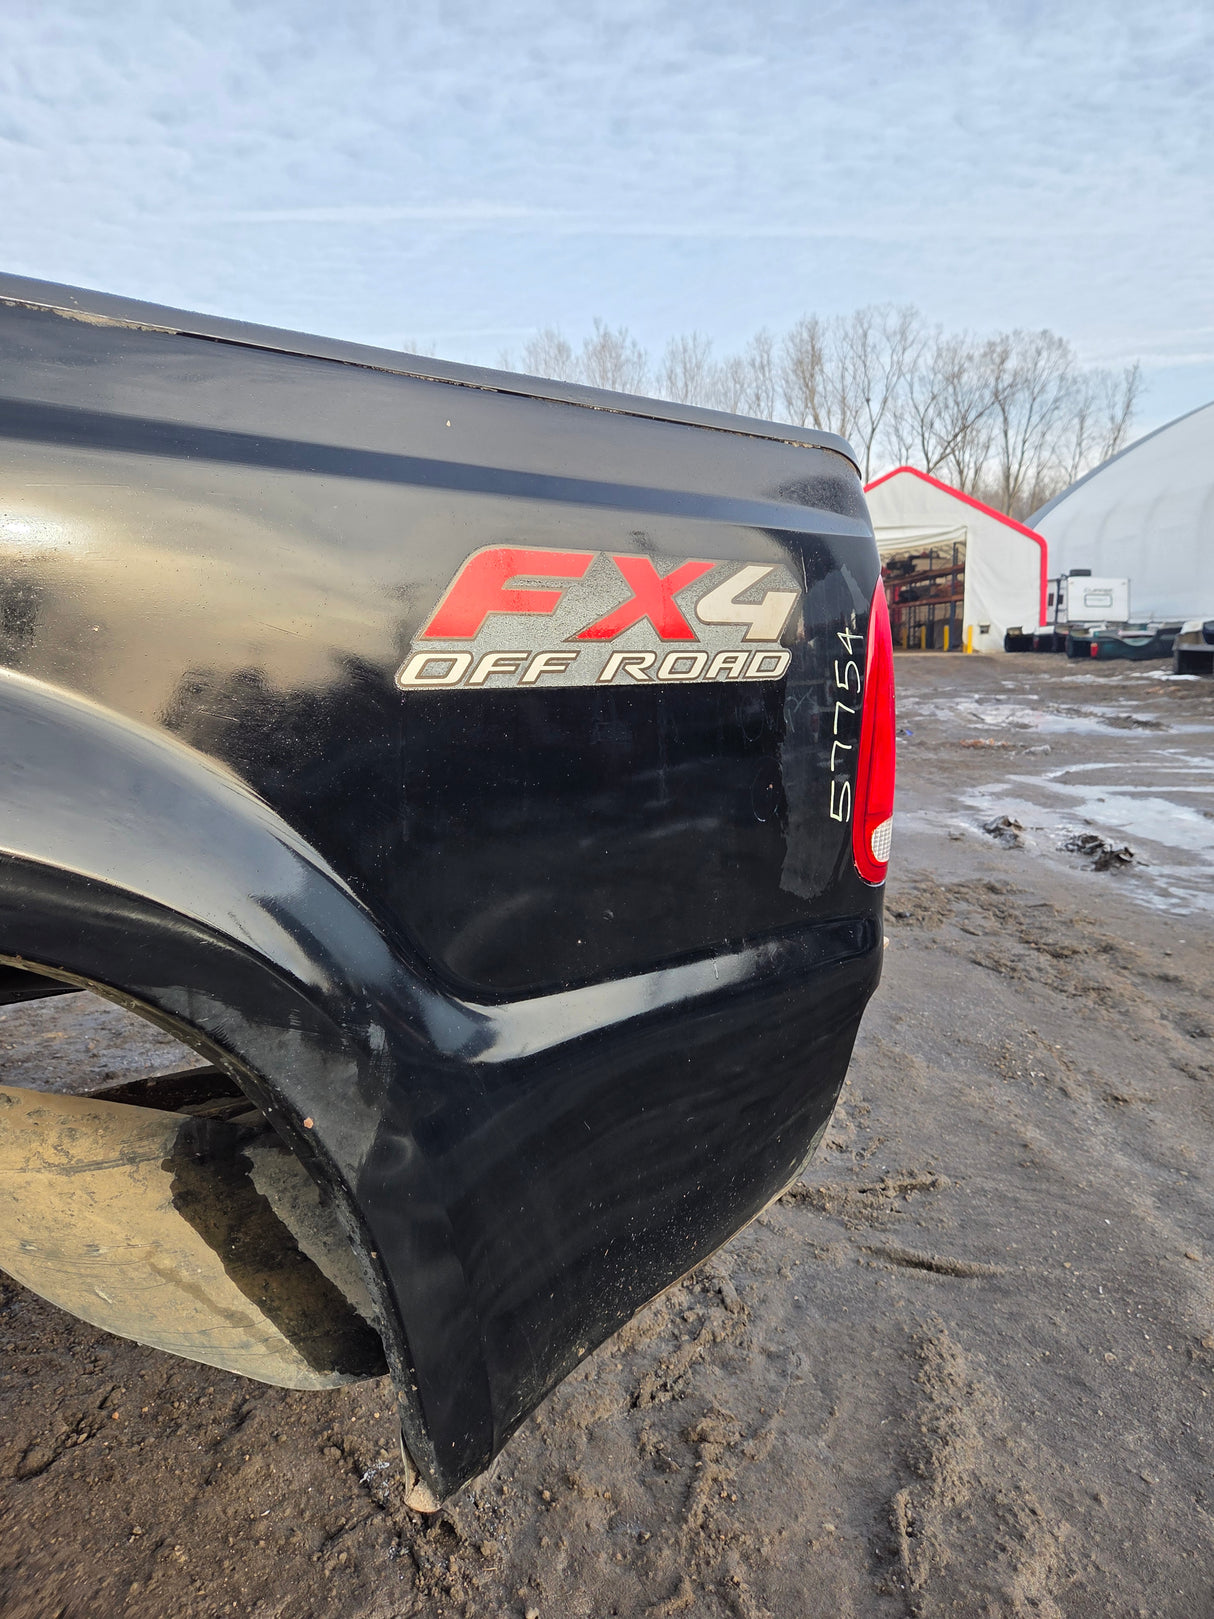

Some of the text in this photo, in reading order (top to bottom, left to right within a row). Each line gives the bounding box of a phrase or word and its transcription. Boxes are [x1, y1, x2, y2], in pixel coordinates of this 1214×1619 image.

[419, 547, 798, 642] FX4
[400, 650, 792, 687] OFF ROAD
[830, 627, 863, 822] 57754
